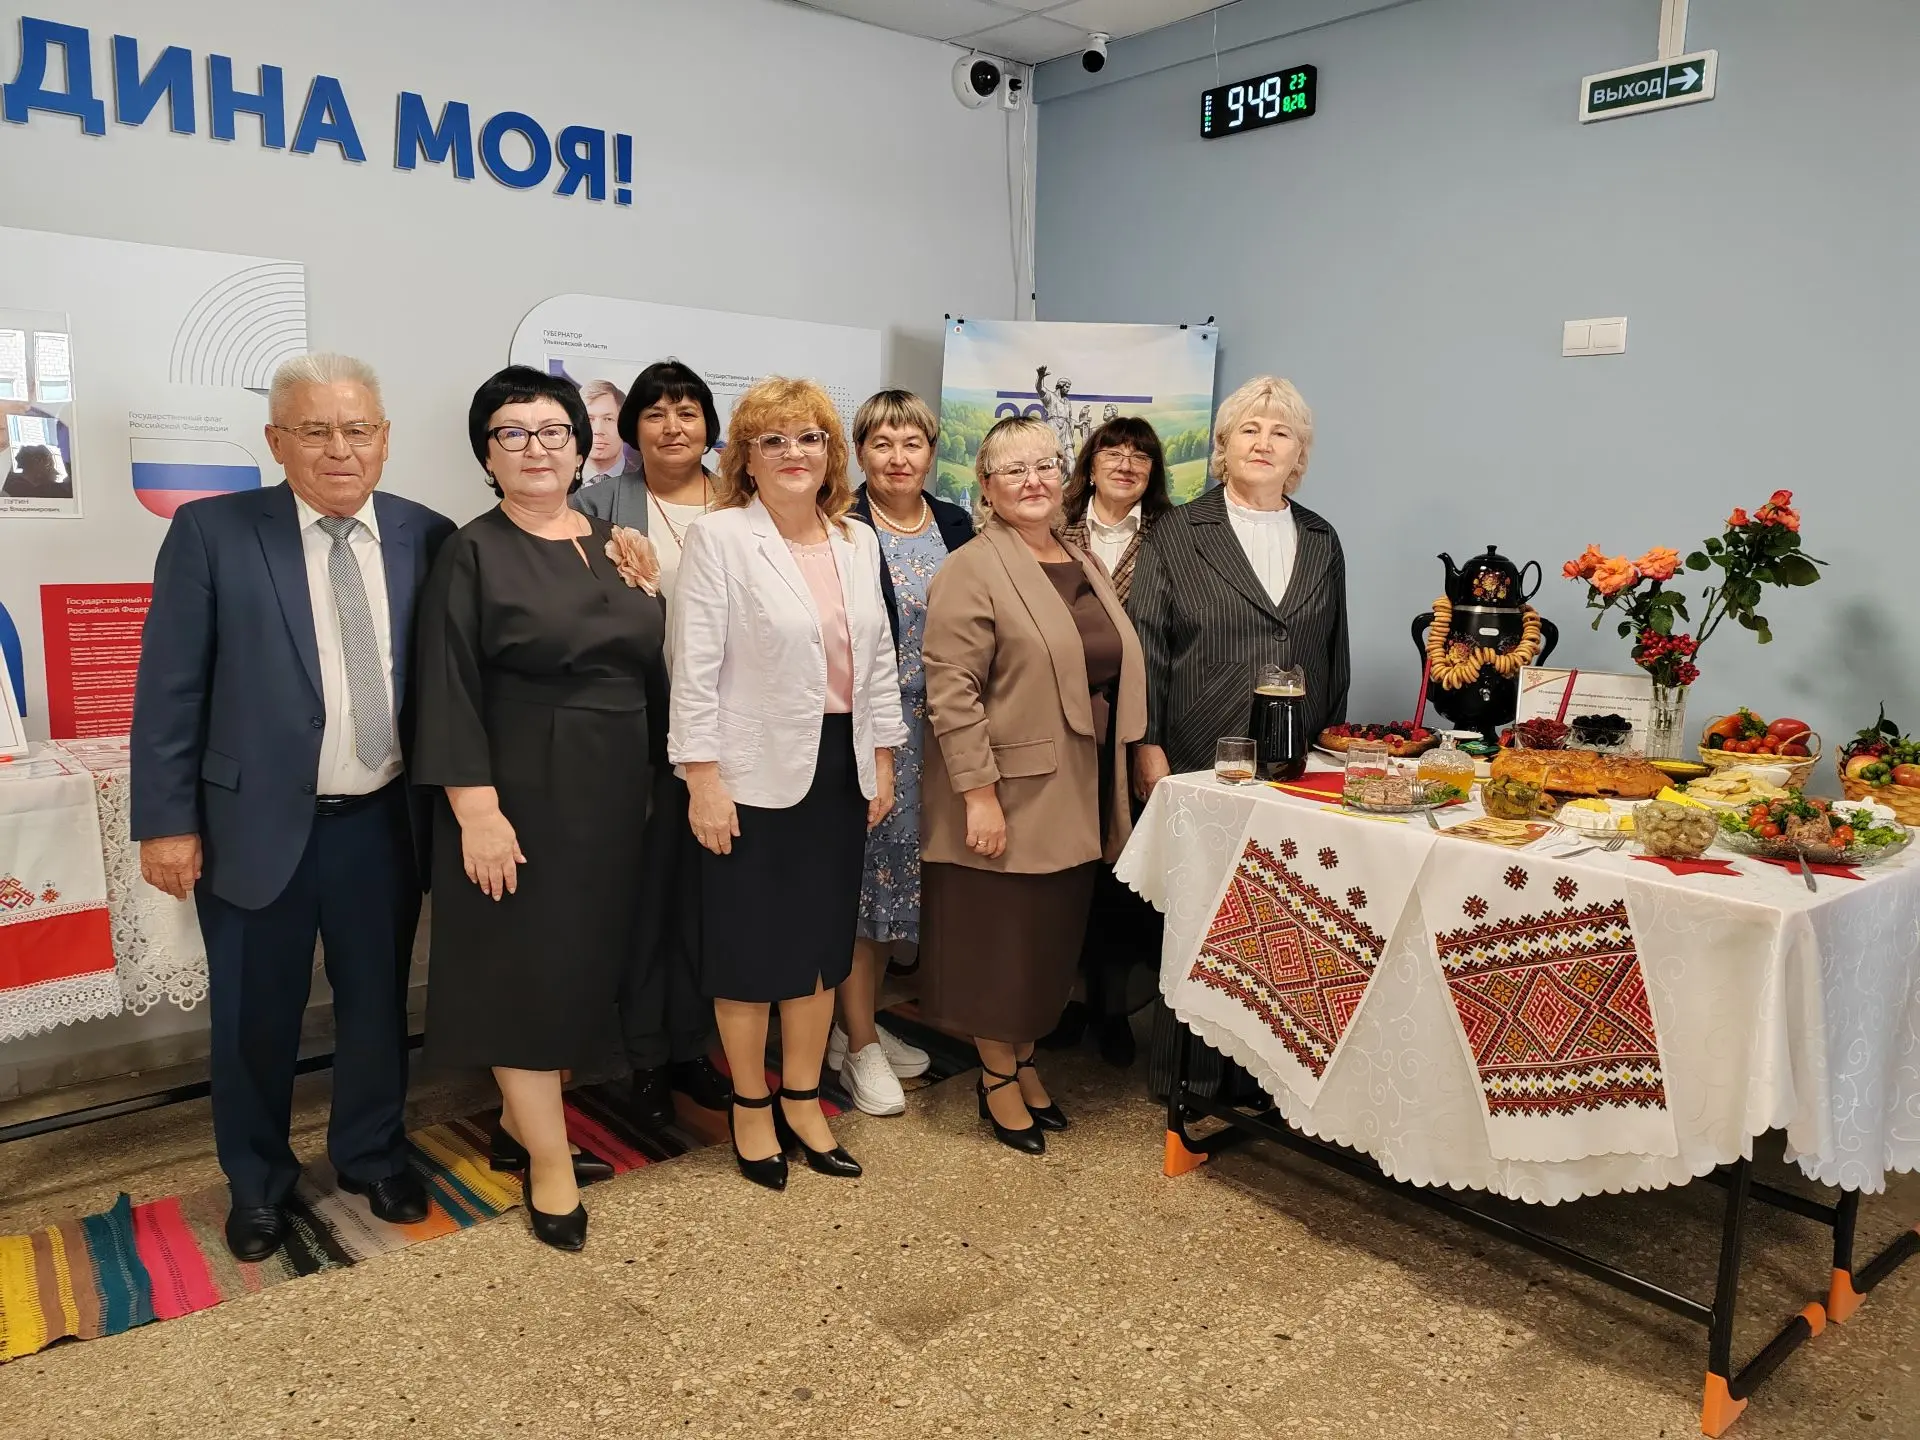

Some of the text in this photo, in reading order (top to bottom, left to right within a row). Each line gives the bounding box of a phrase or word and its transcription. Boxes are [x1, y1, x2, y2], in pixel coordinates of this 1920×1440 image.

[1593, 77, 1662, 105] ВЫХОД
[3, 15, 633, 205] ДИНА МОЯ!
[543, 329, 583, 340] ГУБЕРНАТОР
[66, 597, 142, 606] Государственный
[67, 606, 120, 614] Российской
